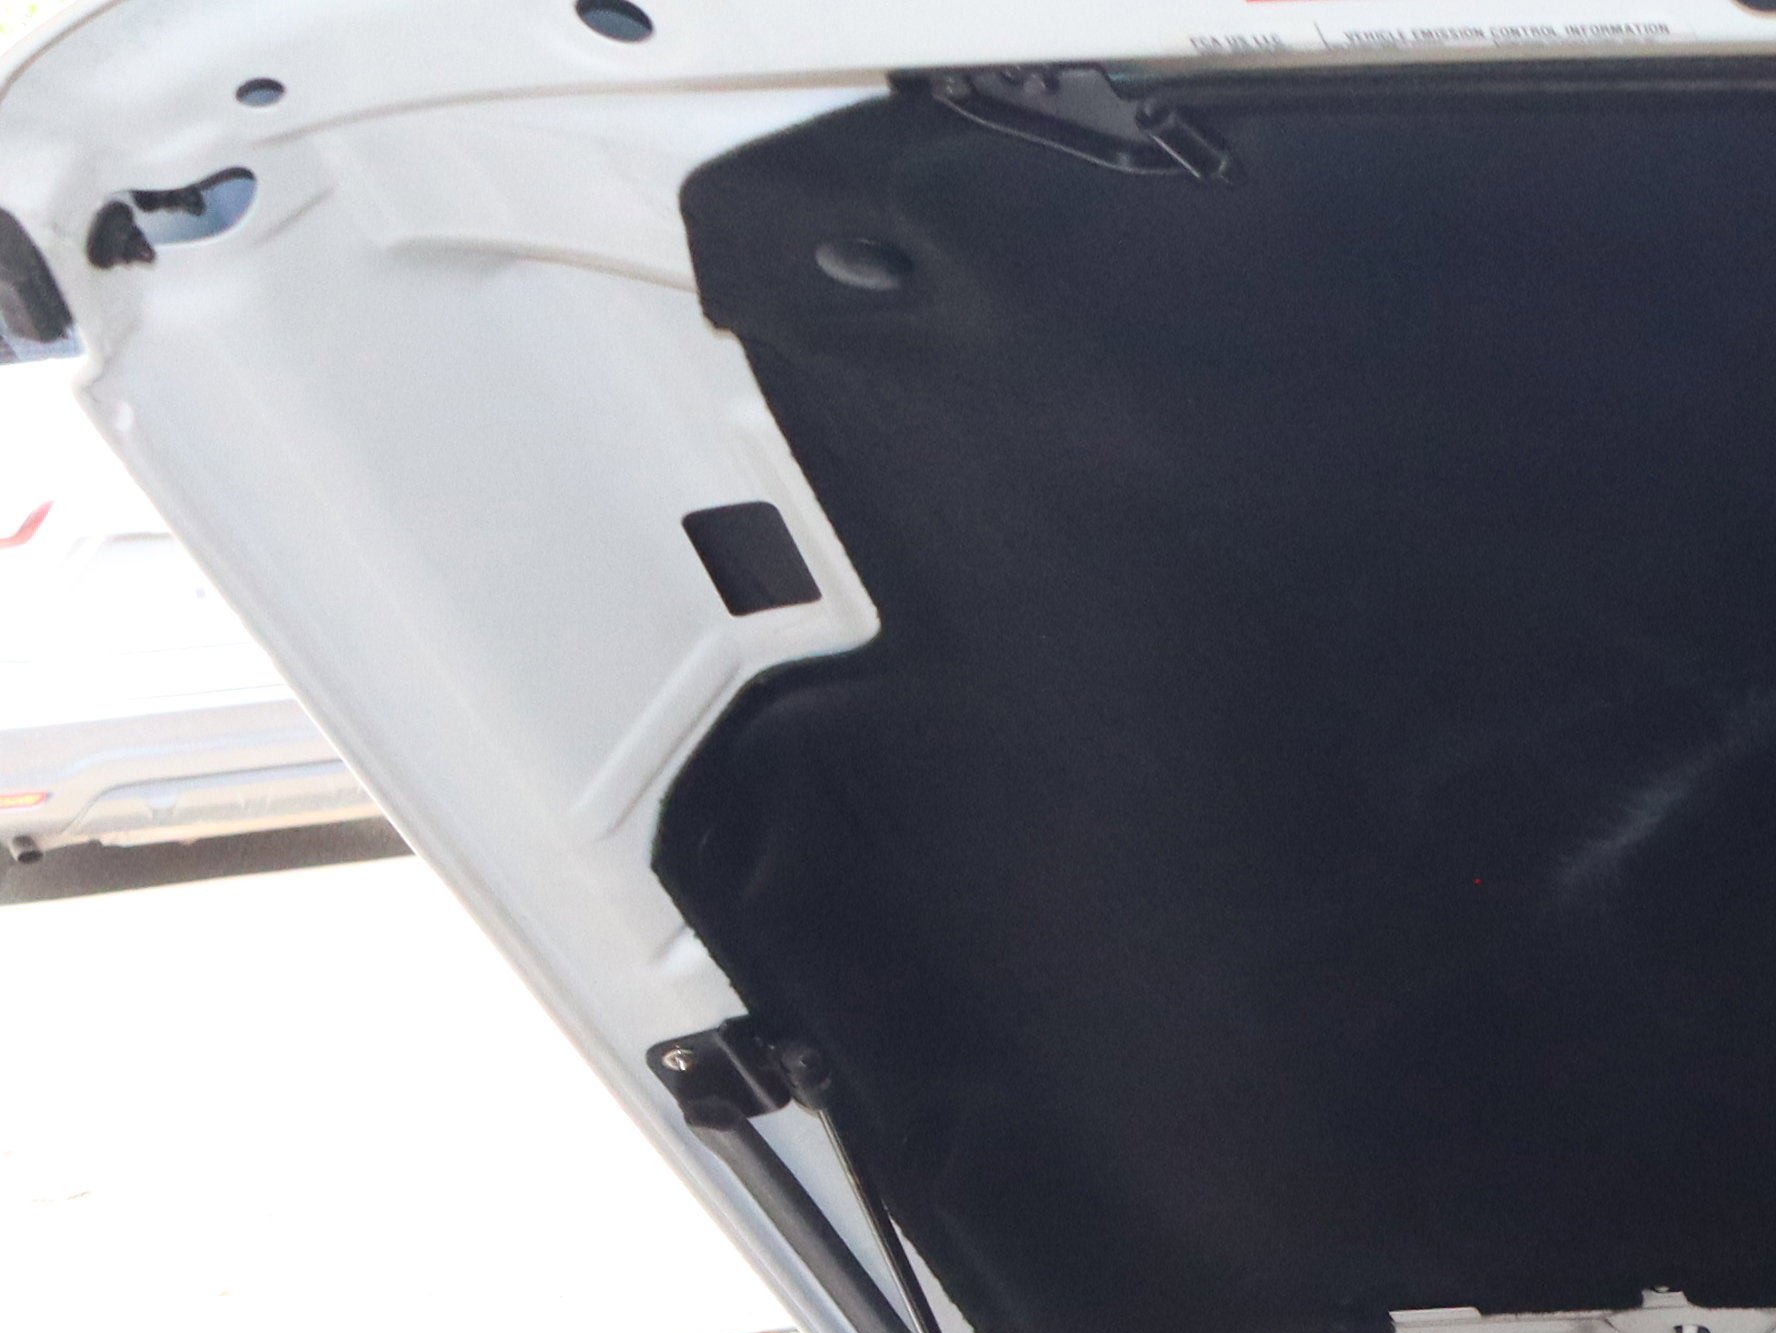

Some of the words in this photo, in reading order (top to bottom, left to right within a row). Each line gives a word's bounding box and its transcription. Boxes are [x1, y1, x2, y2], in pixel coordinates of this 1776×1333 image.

[1409, 26, 1486, 41] EMISSION
[1488, 24, 1559, 40] CONTROL
[1564, 22, 1671, 37] INFORMATION
